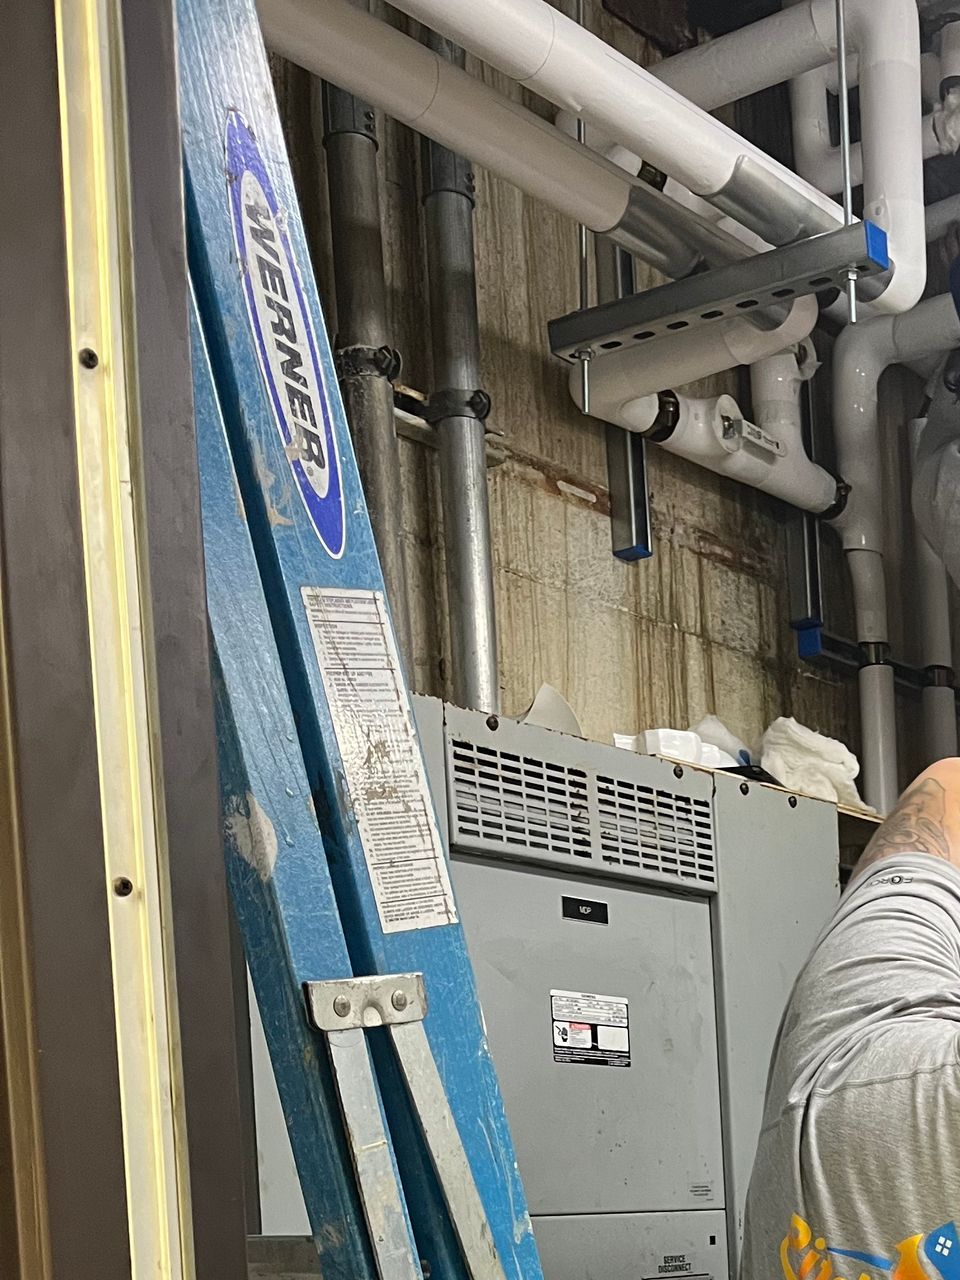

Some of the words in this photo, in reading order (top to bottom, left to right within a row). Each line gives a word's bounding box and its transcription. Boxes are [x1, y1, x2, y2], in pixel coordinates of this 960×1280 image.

[246, 203, 325, 470] WERNER
[664, 1255, 685, 1264] SERVICE
[658, 1263, 691, 1273] DISCONNECT
